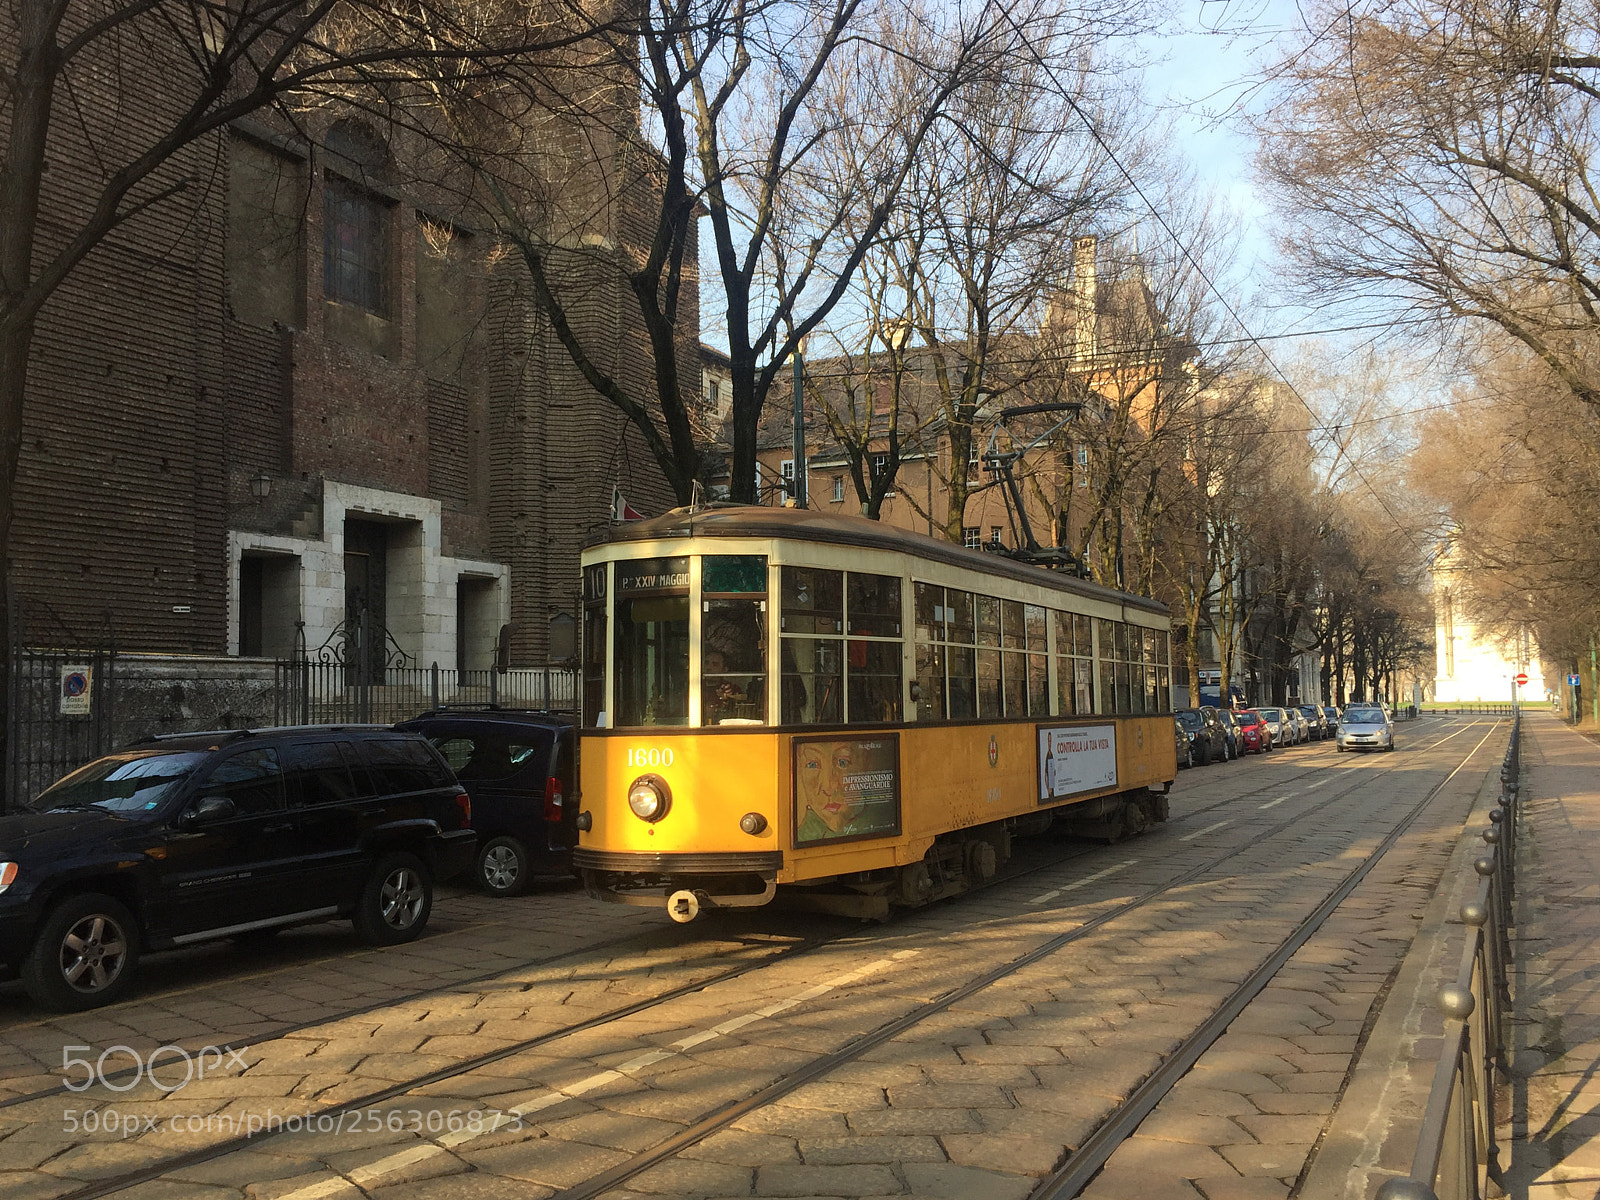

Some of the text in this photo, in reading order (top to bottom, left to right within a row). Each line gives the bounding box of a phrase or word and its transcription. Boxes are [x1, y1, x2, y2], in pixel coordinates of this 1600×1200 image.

[591, 567, 606, 599] 10
[635, 575, 656, 588] XXIV
[659, 573, 690, 586] MAGGIO
[1056, 738, 1109, 754] CONTROLLA LA TUA VISTA
[627, 747, 674, 767] 1600
[843, 773, 893, 784] IMPRESSIONISMO
[848, 781, 891, 791] AVANGUARDIE
